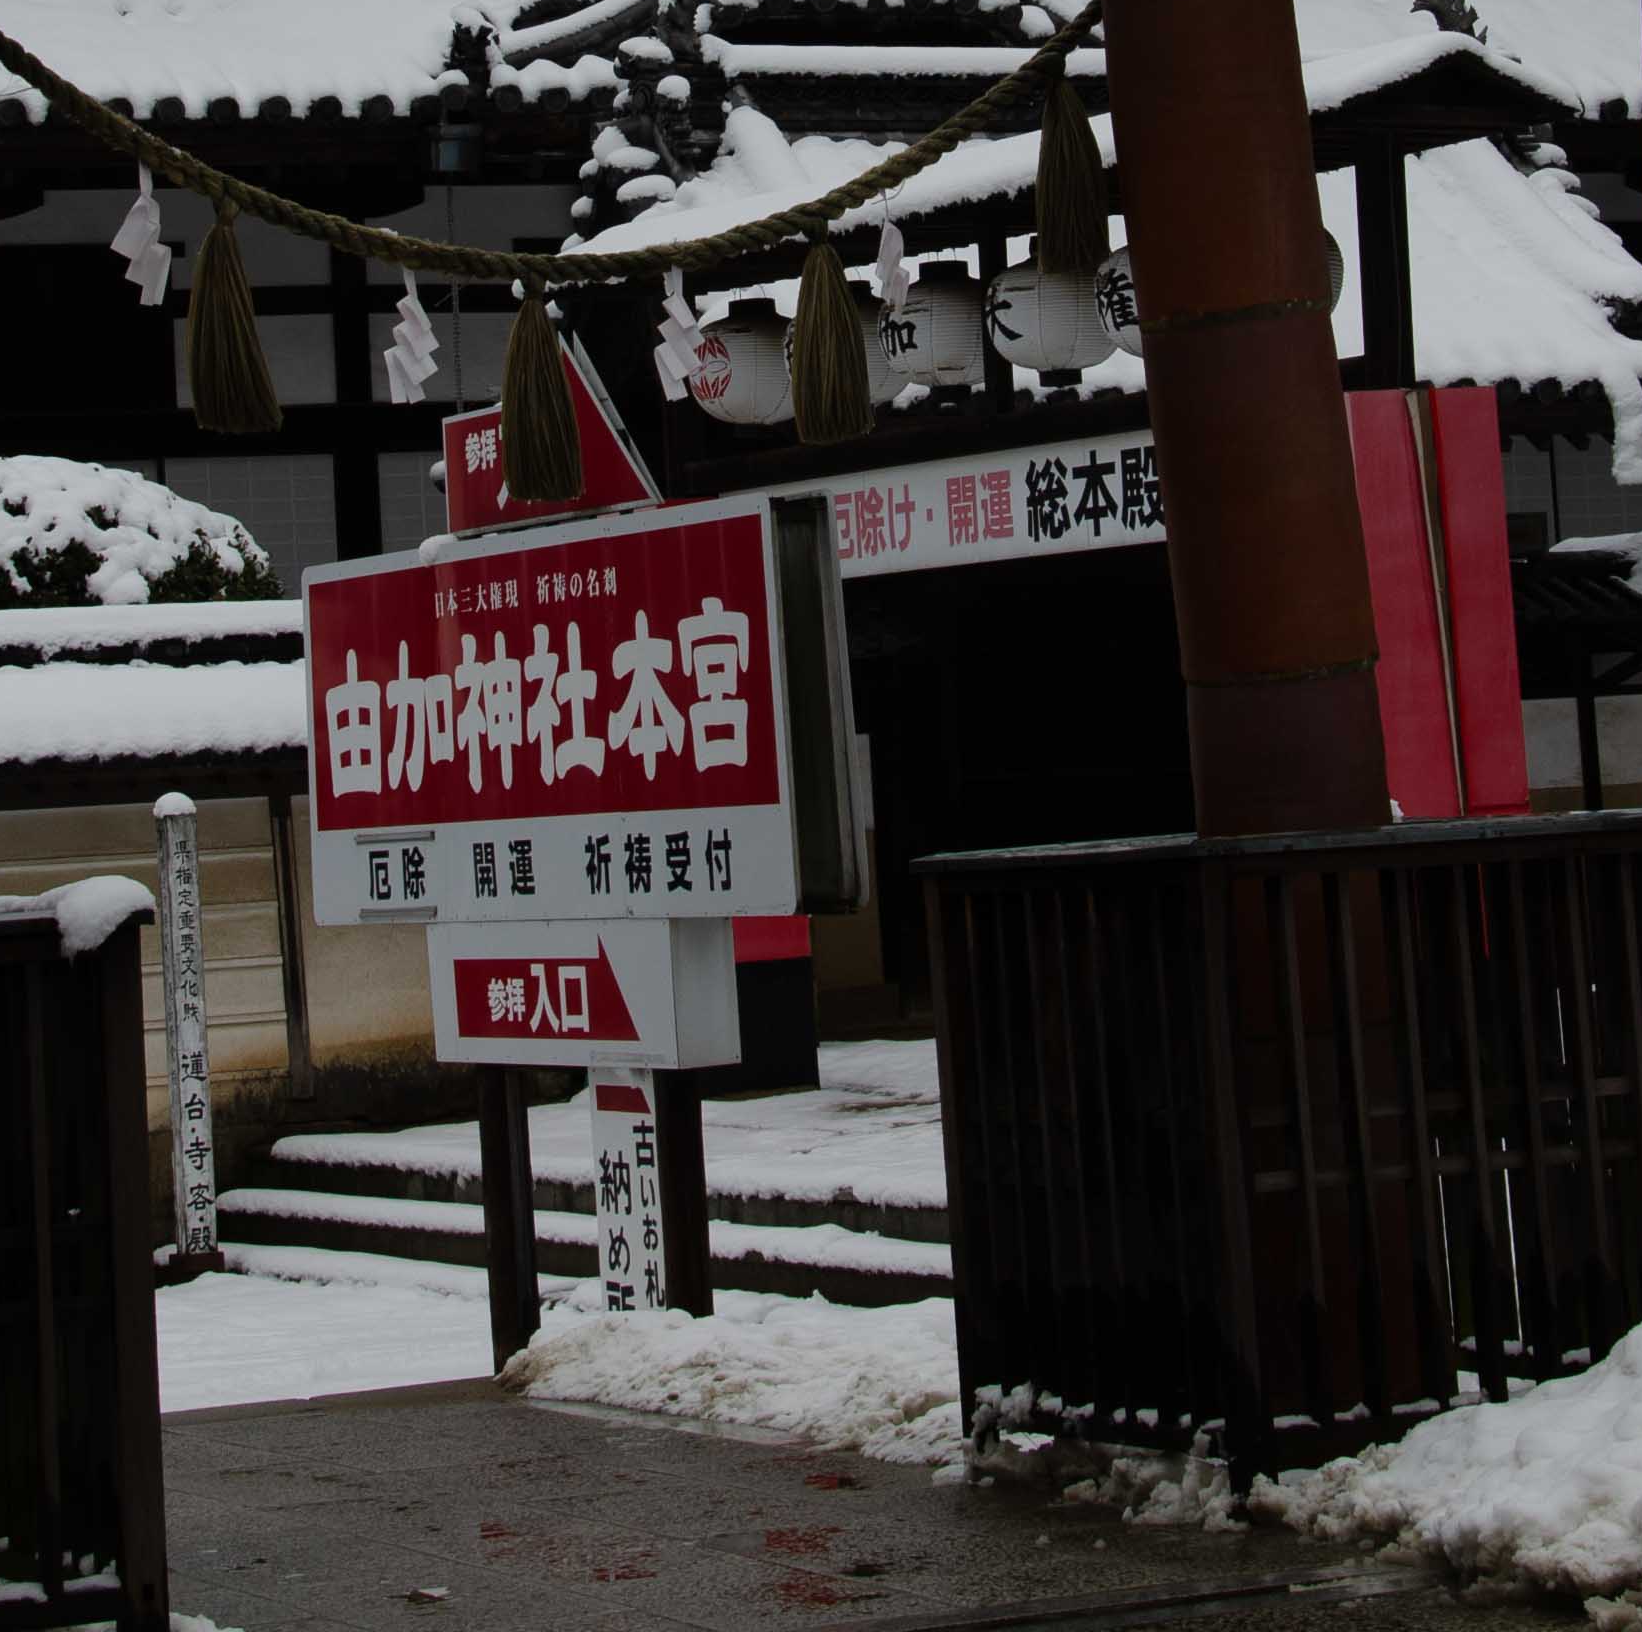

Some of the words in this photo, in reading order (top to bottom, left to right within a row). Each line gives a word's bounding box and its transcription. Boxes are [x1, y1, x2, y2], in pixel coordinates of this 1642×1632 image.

[464, 431, 498, 475] 参拝
[1025, 446, 1166, 544] 総本殿
[433, 576, 519, 621] 日本三大権現
[325, 596, 751, 799] 由加神社本宮
[367, 844, 427, 901] 厄除
[471, 839, 537, 899] 開運
[584, 828, 734, 896] 祈祷受付
[487, 962, 590, 1034] 参拝入口
[632, 1120, 665, 1308] 古いお札
